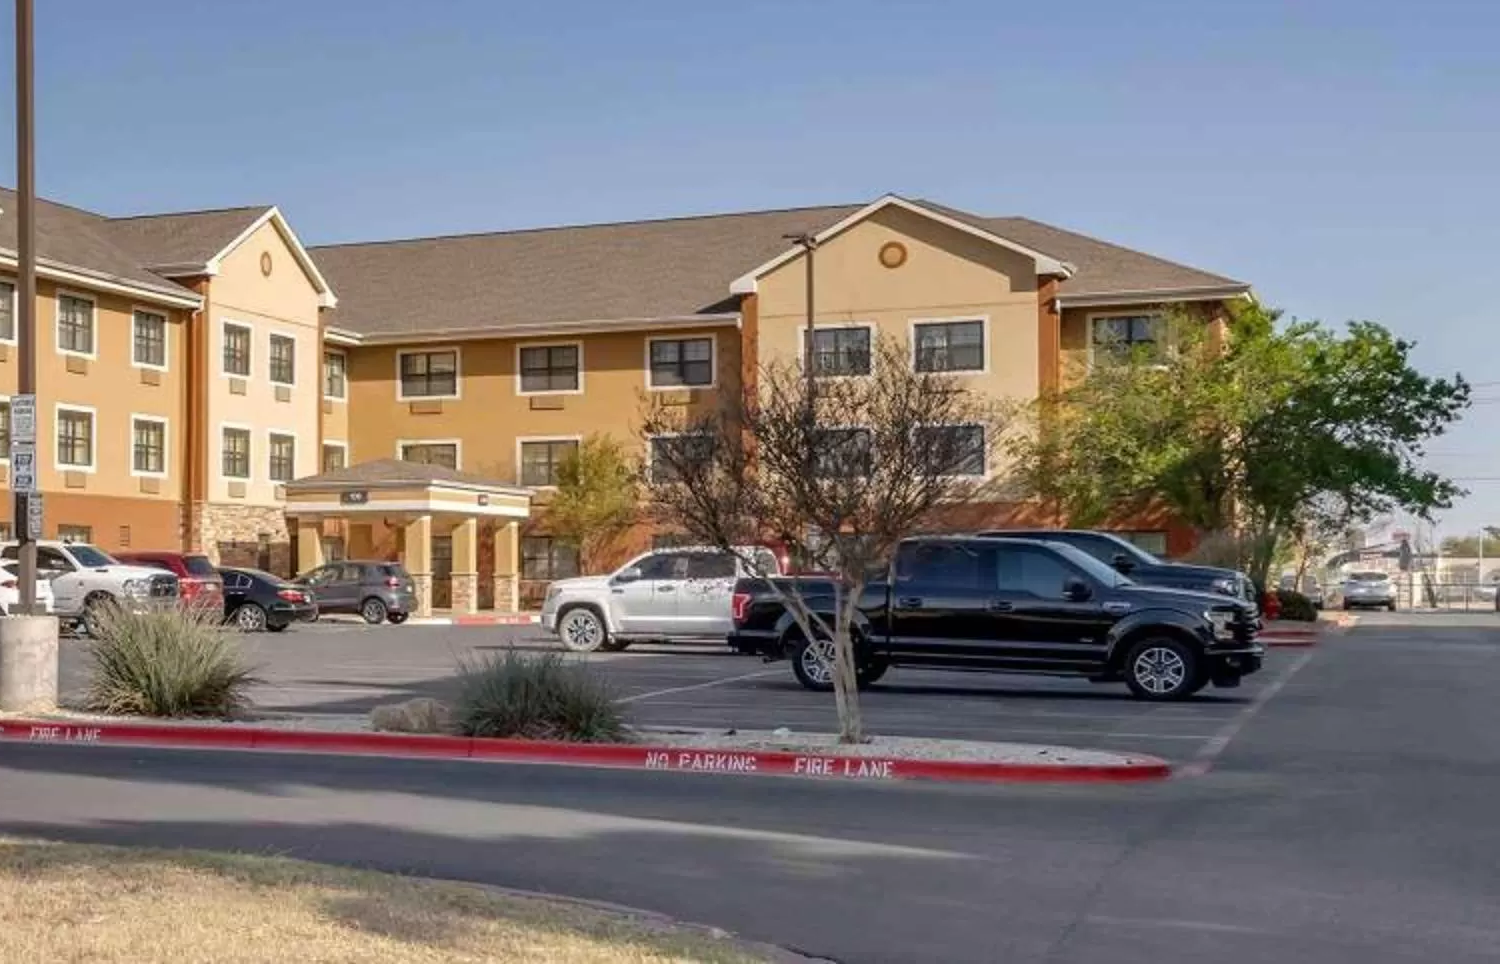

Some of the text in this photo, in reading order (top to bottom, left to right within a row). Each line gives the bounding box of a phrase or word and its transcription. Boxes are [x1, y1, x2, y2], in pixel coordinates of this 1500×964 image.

[29, 726, 61, 741] FIRE
[65, 727, 102, 743] LANE
[645, 751, 894, 778] NO PARKING FIRE LANE
